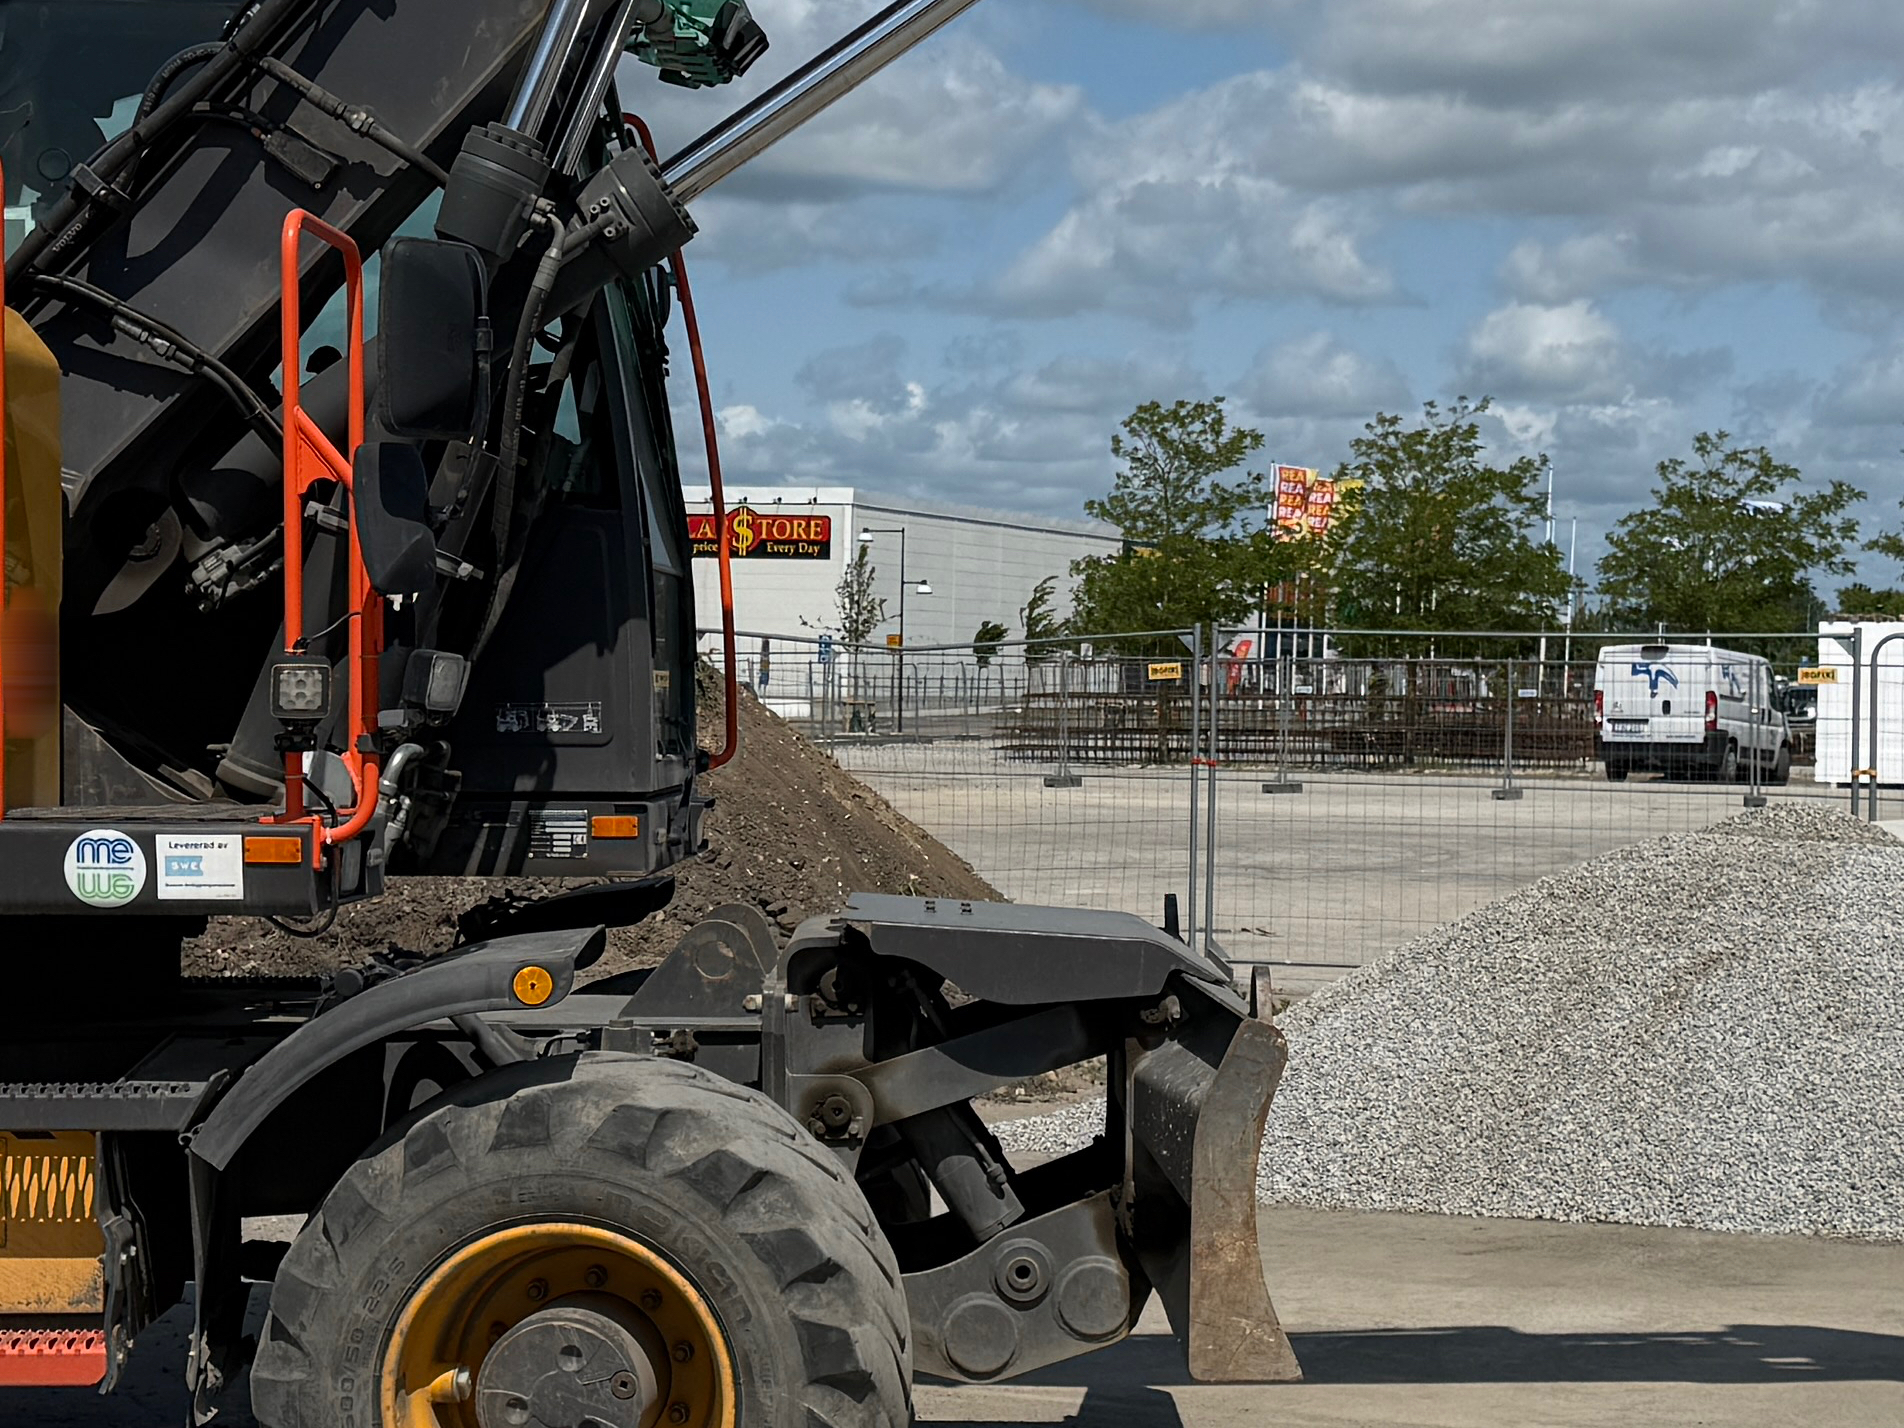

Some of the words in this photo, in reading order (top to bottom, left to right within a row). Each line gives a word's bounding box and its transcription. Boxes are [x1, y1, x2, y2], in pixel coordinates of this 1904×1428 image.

[1280, 481, 1304, 493] REA
[767, 542, 795, 555] Every
[799, 542, 821, 556] Day
